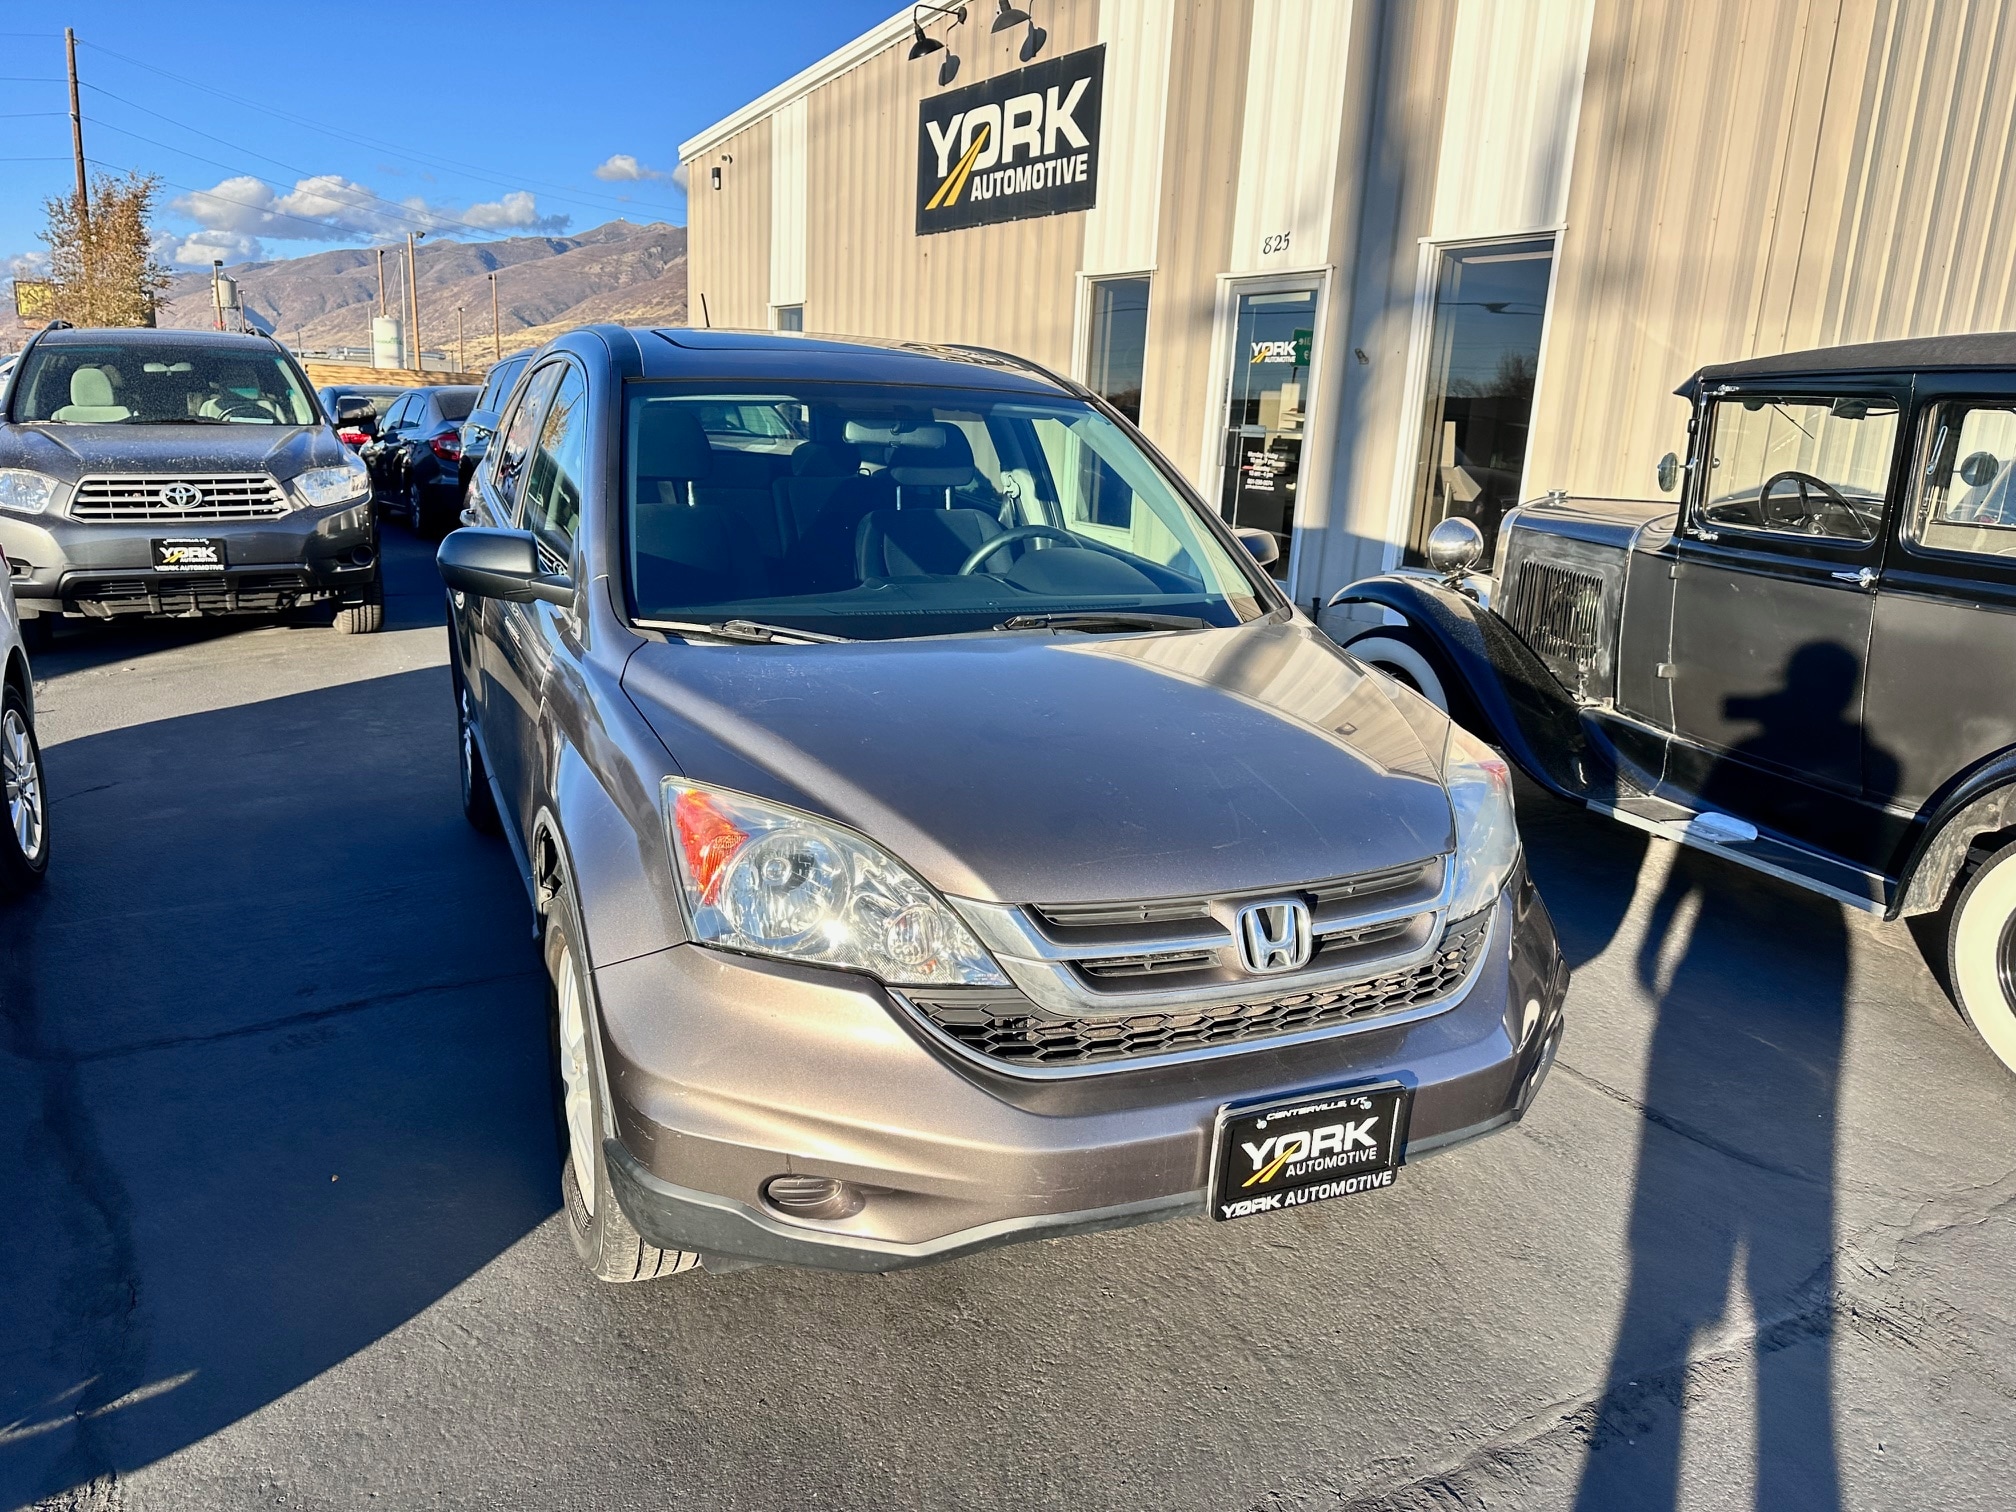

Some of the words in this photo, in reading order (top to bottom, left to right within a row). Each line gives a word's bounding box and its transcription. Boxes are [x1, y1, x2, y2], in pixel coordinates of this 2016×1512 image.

[925, 77, 1092, 178] YORK
[970, 153, 1088, 202] AUTOMOTIVE
[1263, 231, 1290, 255] 825
[1251, 341, 1297, 356] YORK
[159, 546, 217, 558] YORK
[1241, 1116, 1379, 1170] YORK
[1285, 1147, 1378, 1178] AUTOMOTIVE
[1221, 1194, 1282, 1219] YORK
[1285, 1171, 1392, 1206] AUTOMOTIVE
